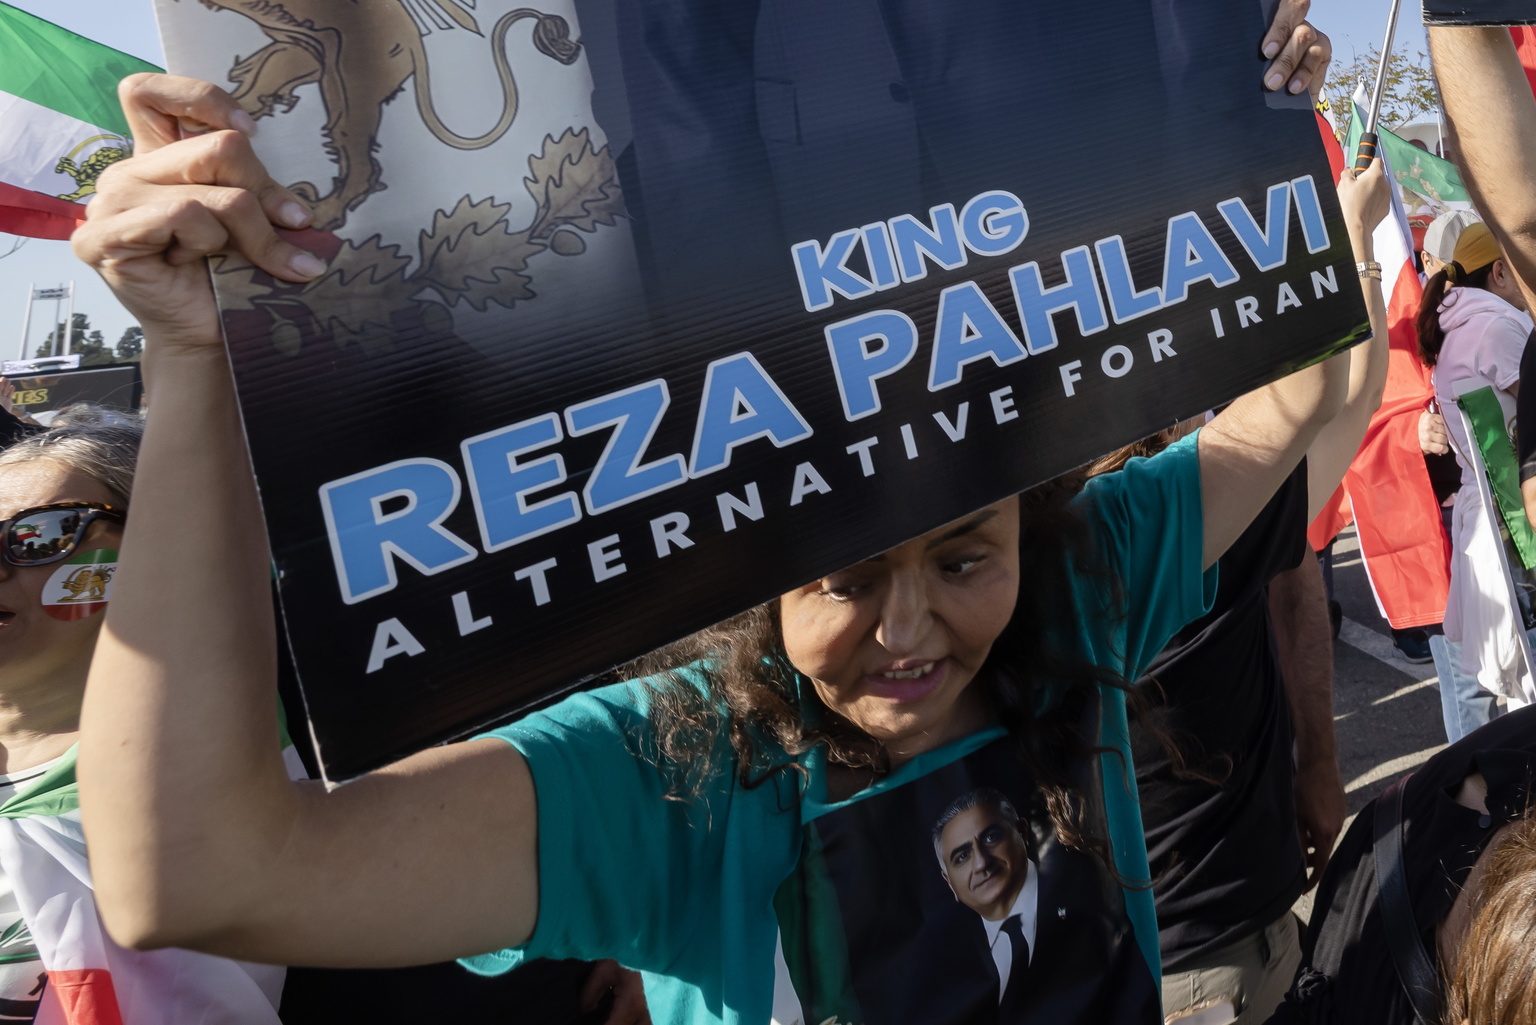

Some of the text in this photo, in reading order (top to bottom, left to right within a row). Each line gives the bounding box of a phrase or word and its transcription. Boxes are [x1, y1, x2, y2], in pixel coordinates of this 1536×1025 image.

[319, 174, 1330, 605] REZA PAHLAVI
[791, 190, 1030, 313] KING
[365, 265, 1340, 674] ALTERNATIVE FOR IRAN
